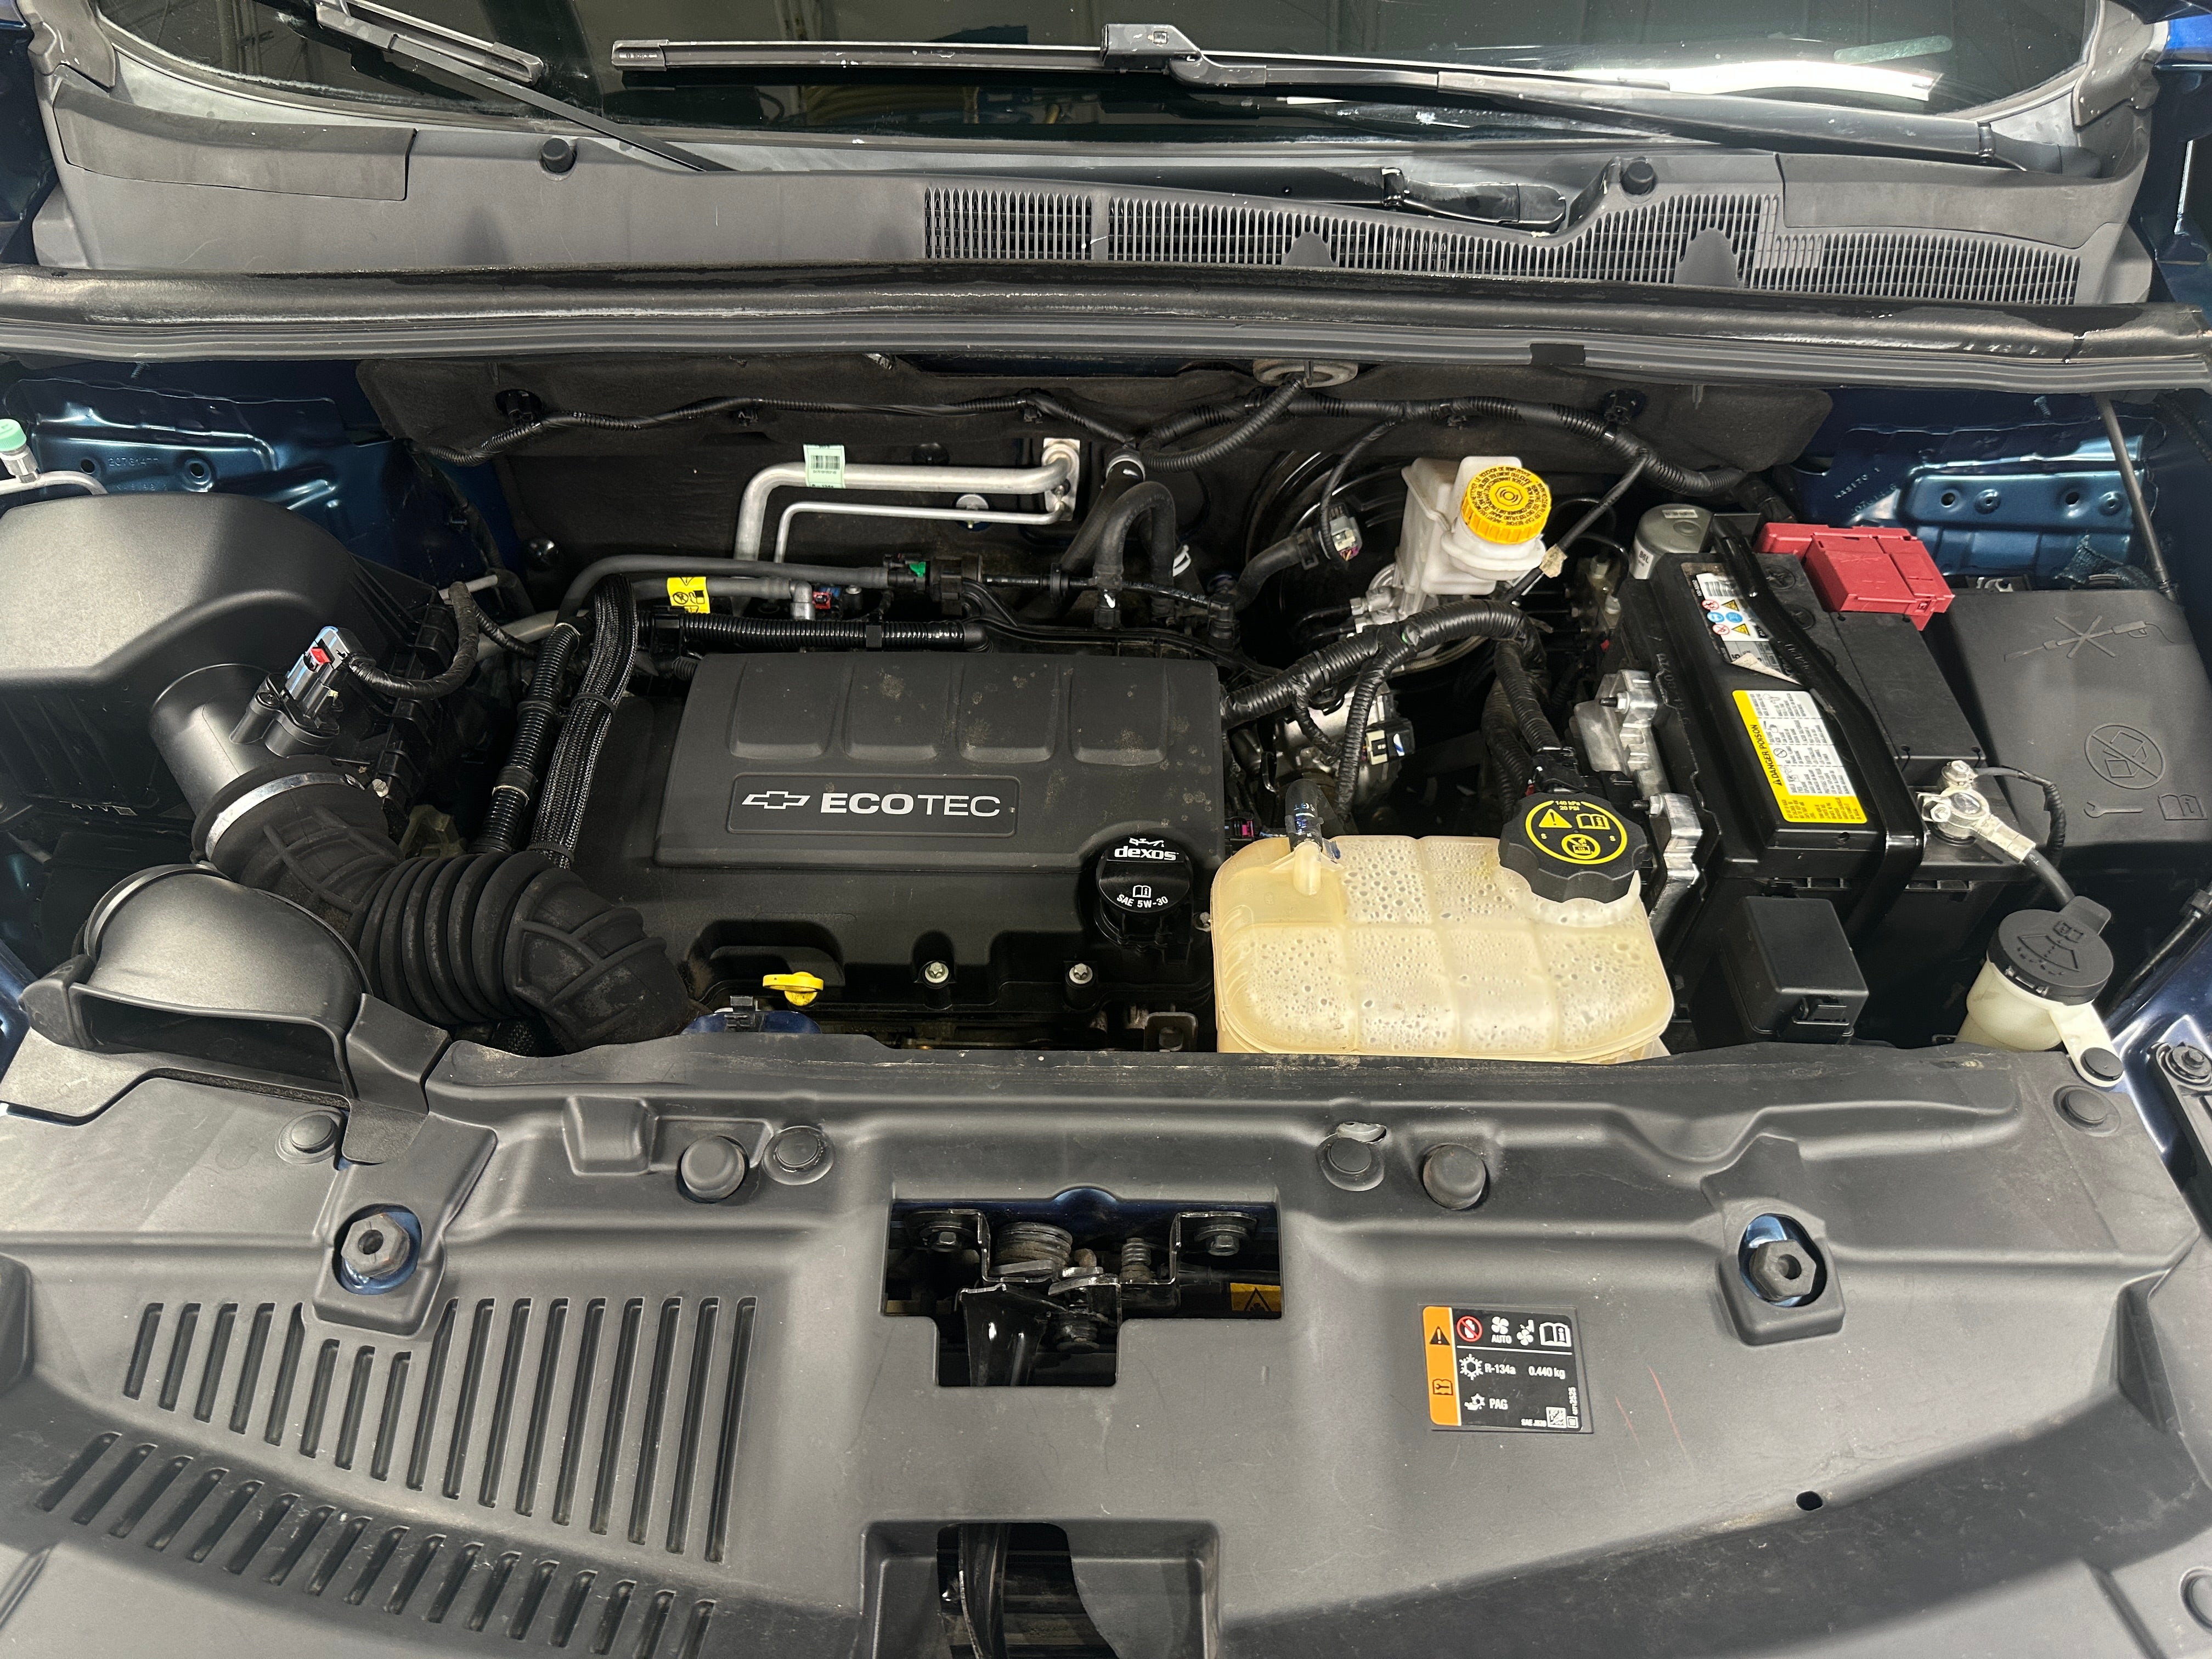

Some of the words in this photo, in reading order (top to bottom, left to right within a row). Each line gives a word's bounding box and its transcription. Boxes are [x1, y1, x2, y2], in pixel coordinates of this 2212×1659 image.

[1750, 724, 1779, 778] DANGER/POISON
[820, 792, 1001, 817] ECOTEC
[1116, 894, 1134, 908] SAE
[1137, 895, 1169, 909] 5W-30
[1491, 1334, 1512, 1344] AUTO
[1485, 1363, 1516, 1375] R-134a
[1528, 1366, 1553, 1377] 0.440
[1554, 1368, 1566, 1379] kg
[1489, 1398, 1508, 1410] PAG
